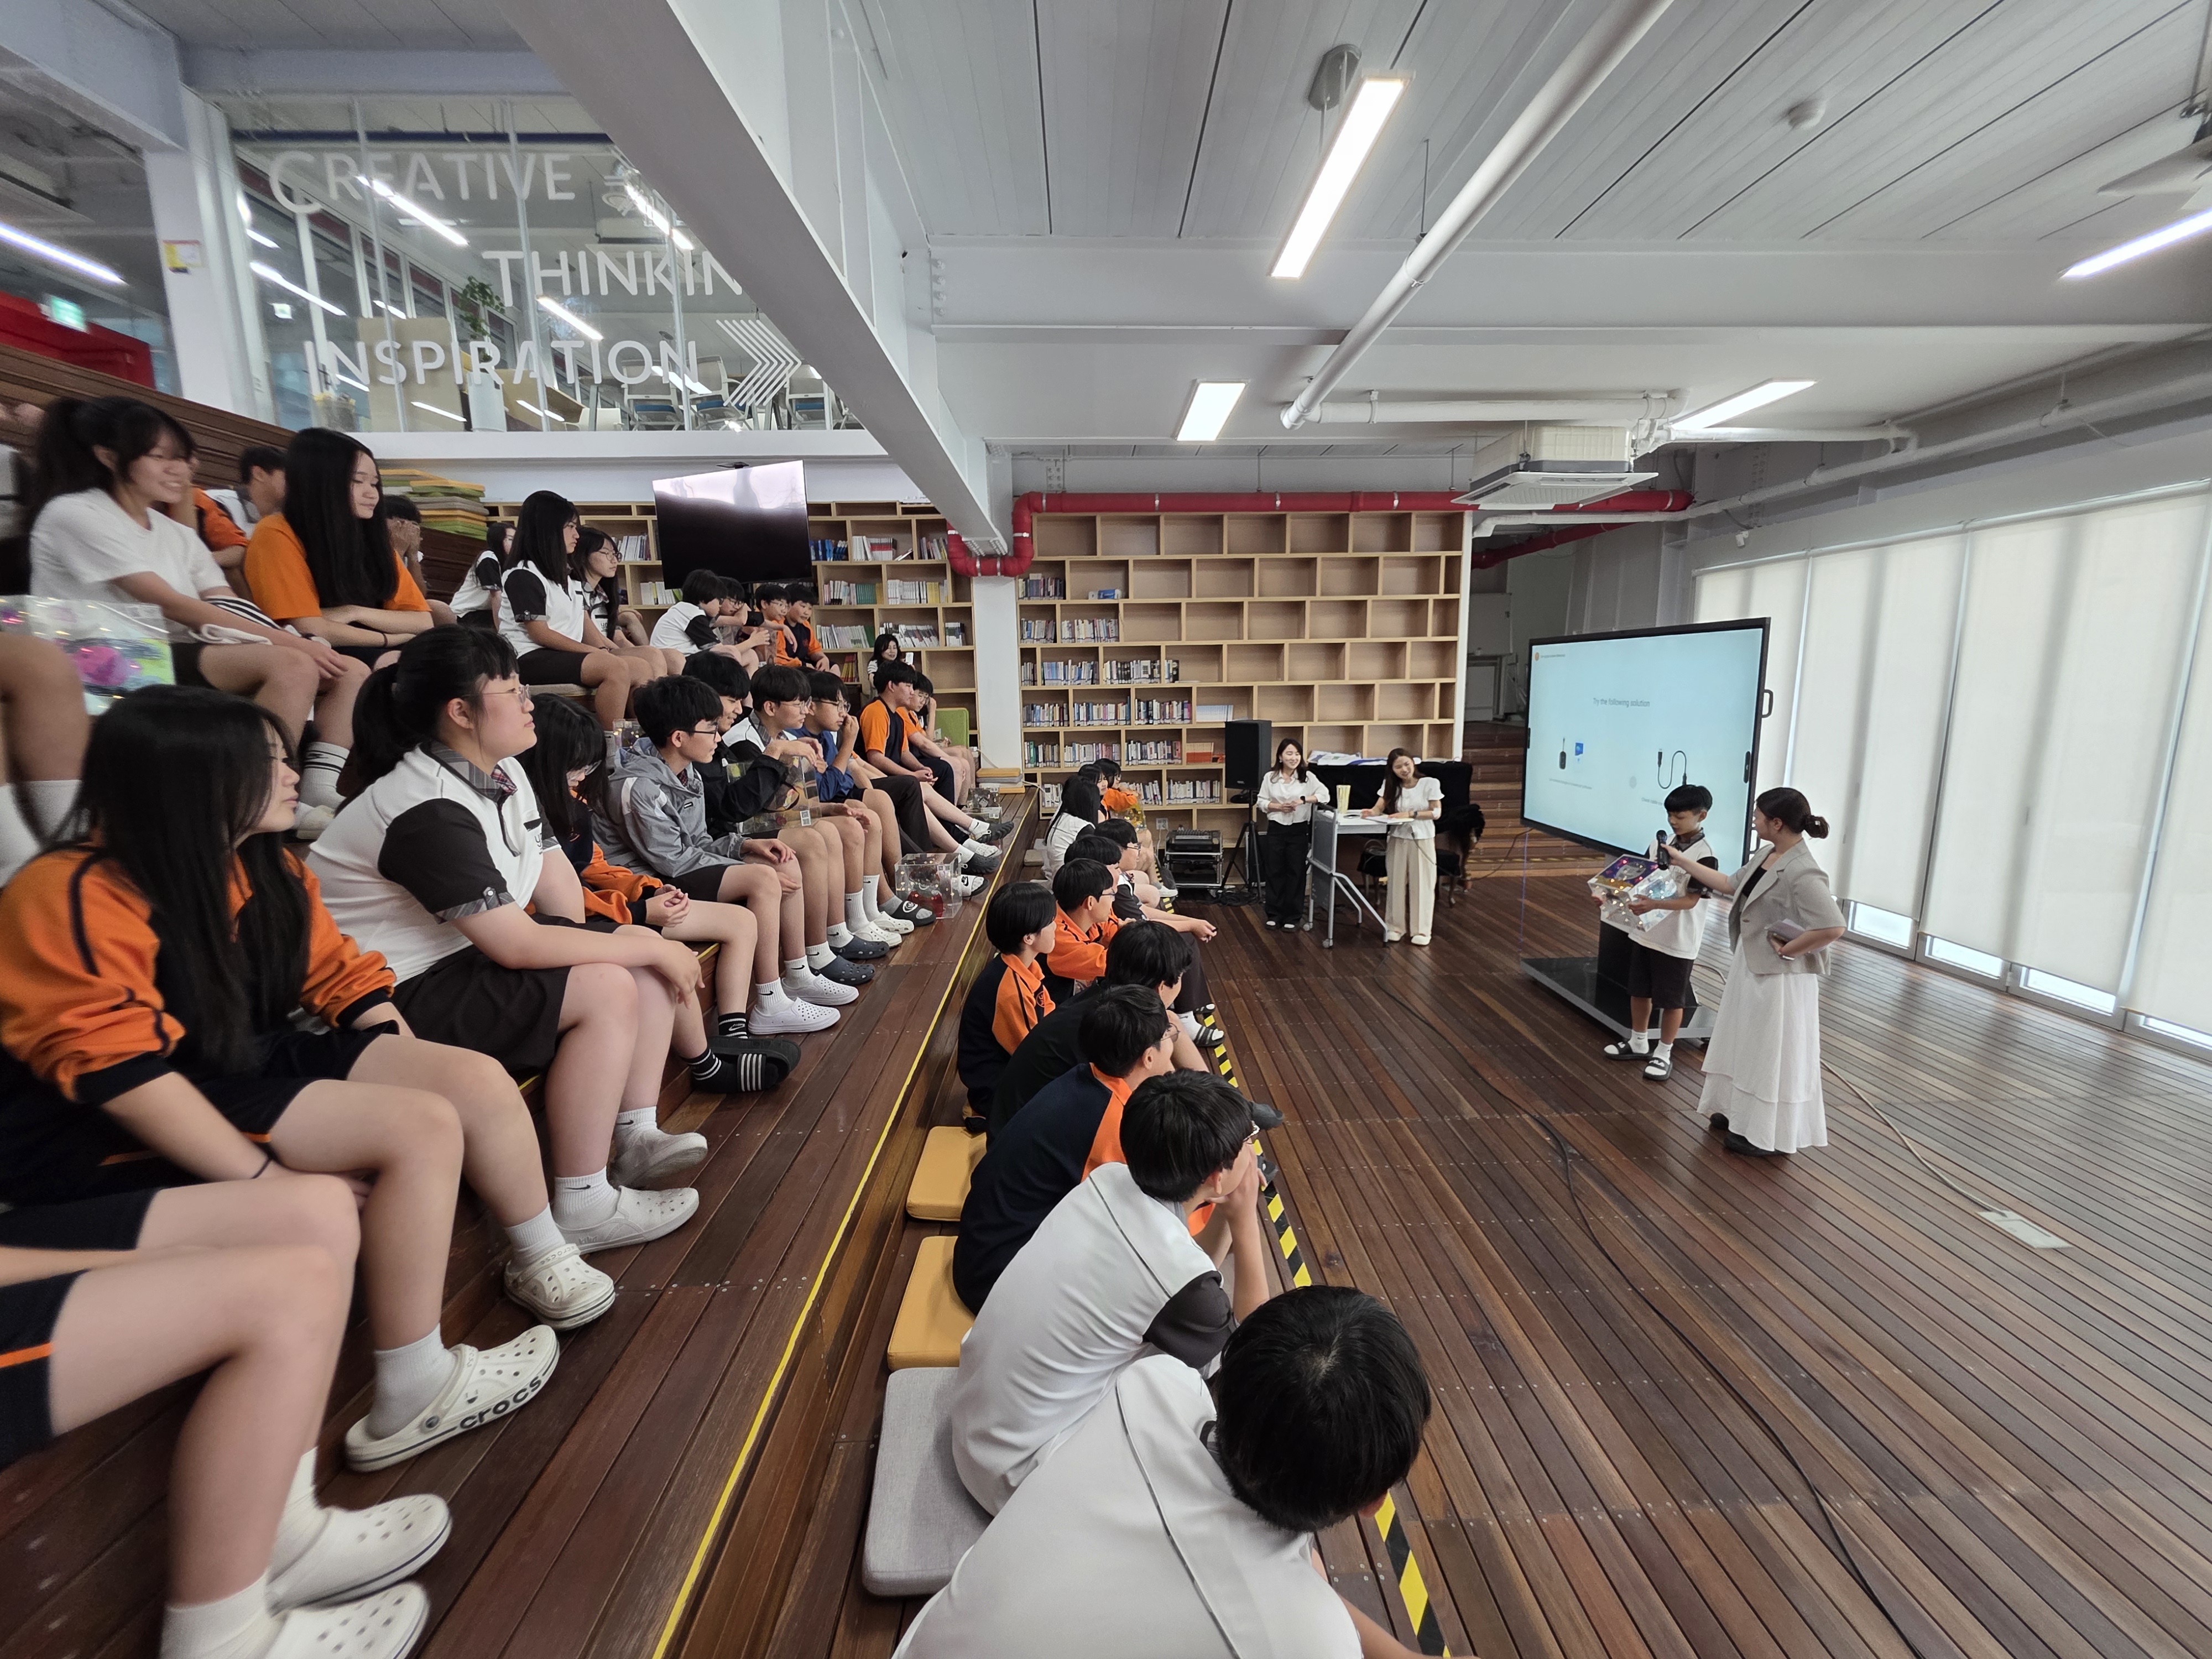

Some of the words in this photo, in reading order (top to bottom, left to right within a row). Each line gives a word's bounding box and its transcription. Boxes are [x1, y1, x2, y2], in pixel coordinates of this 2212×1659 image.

[269, 150, 576, 214] CREATIVE
[482, 251, 742, 307] THINKIN
[304, 340, 698, 394] INSPIRATION
[1608, 698, 1629, 708] following
[1630, 699, 1650, 707] solution
[460, 1376, 541, 1428] crocs
